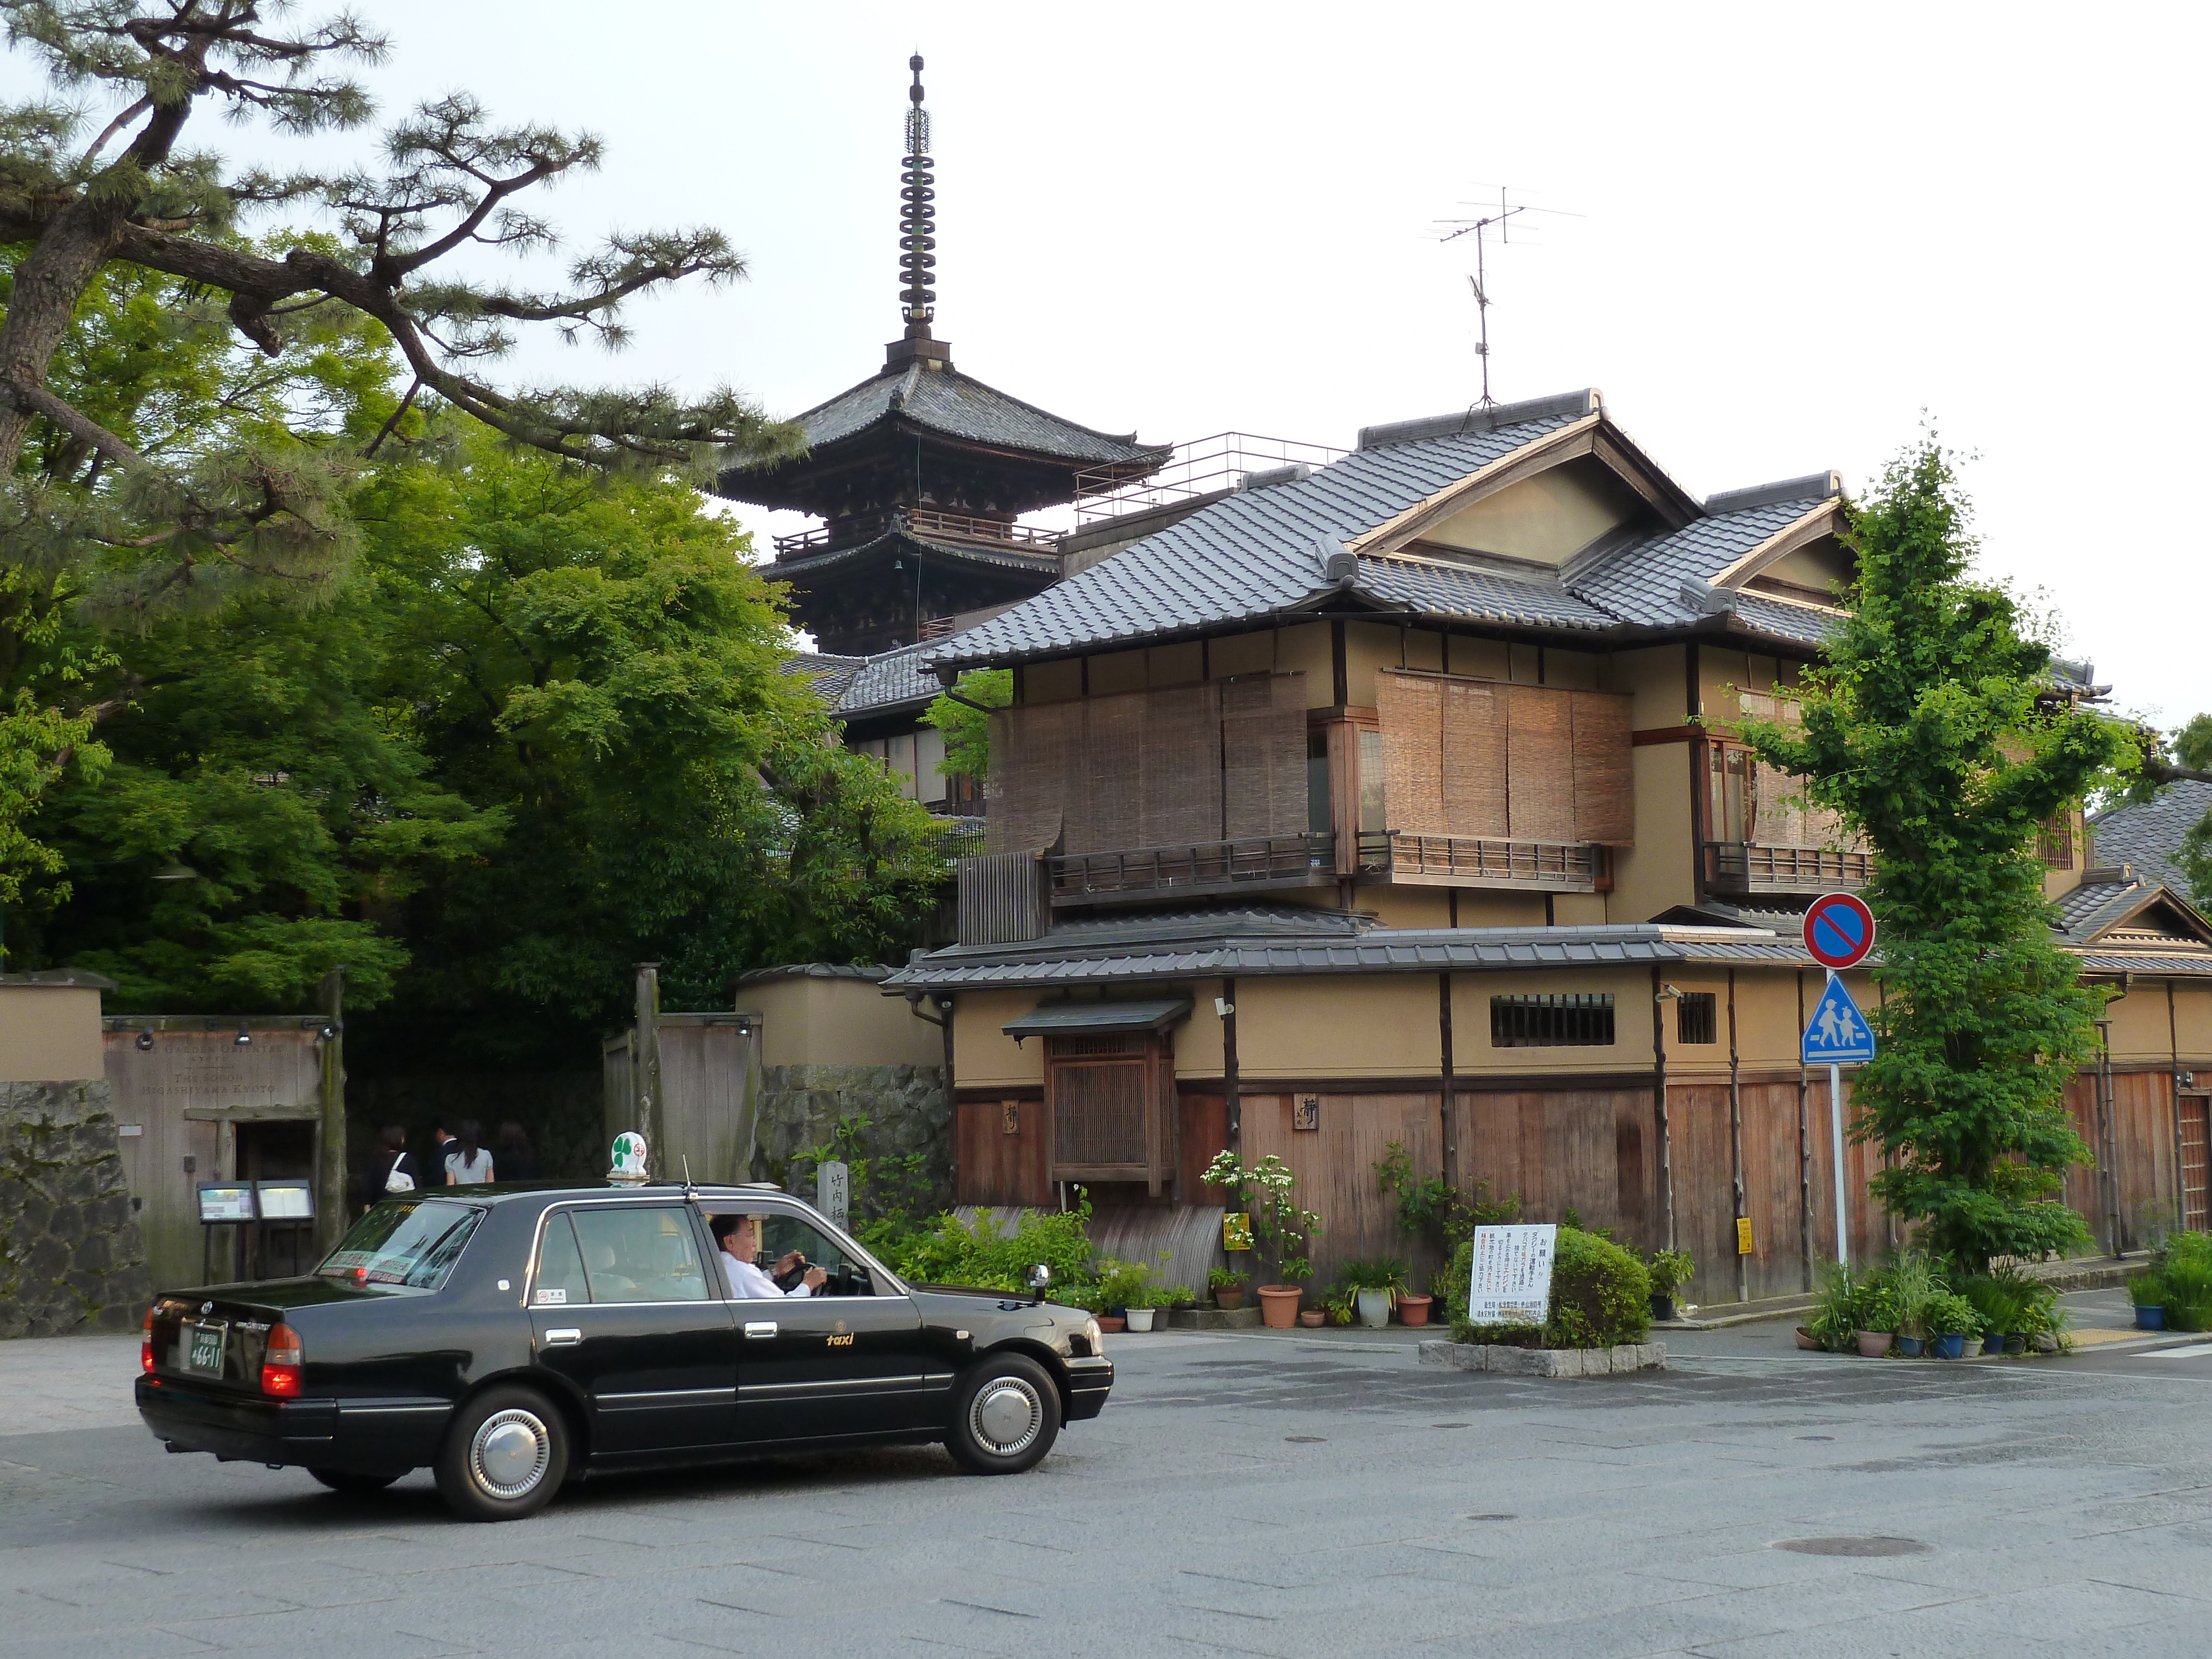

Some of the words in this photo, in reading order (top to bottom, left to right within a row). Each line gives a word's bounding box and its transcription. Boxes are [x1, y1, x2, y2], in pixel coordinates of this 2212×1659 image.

[174, 1073, 198, 1083] THE
[142, 1085, 228, 1094] HIGASHIYAMA
[233, 1084, 275, 1093] KYOTO
[826, 1332, 854, 1346] taxi
